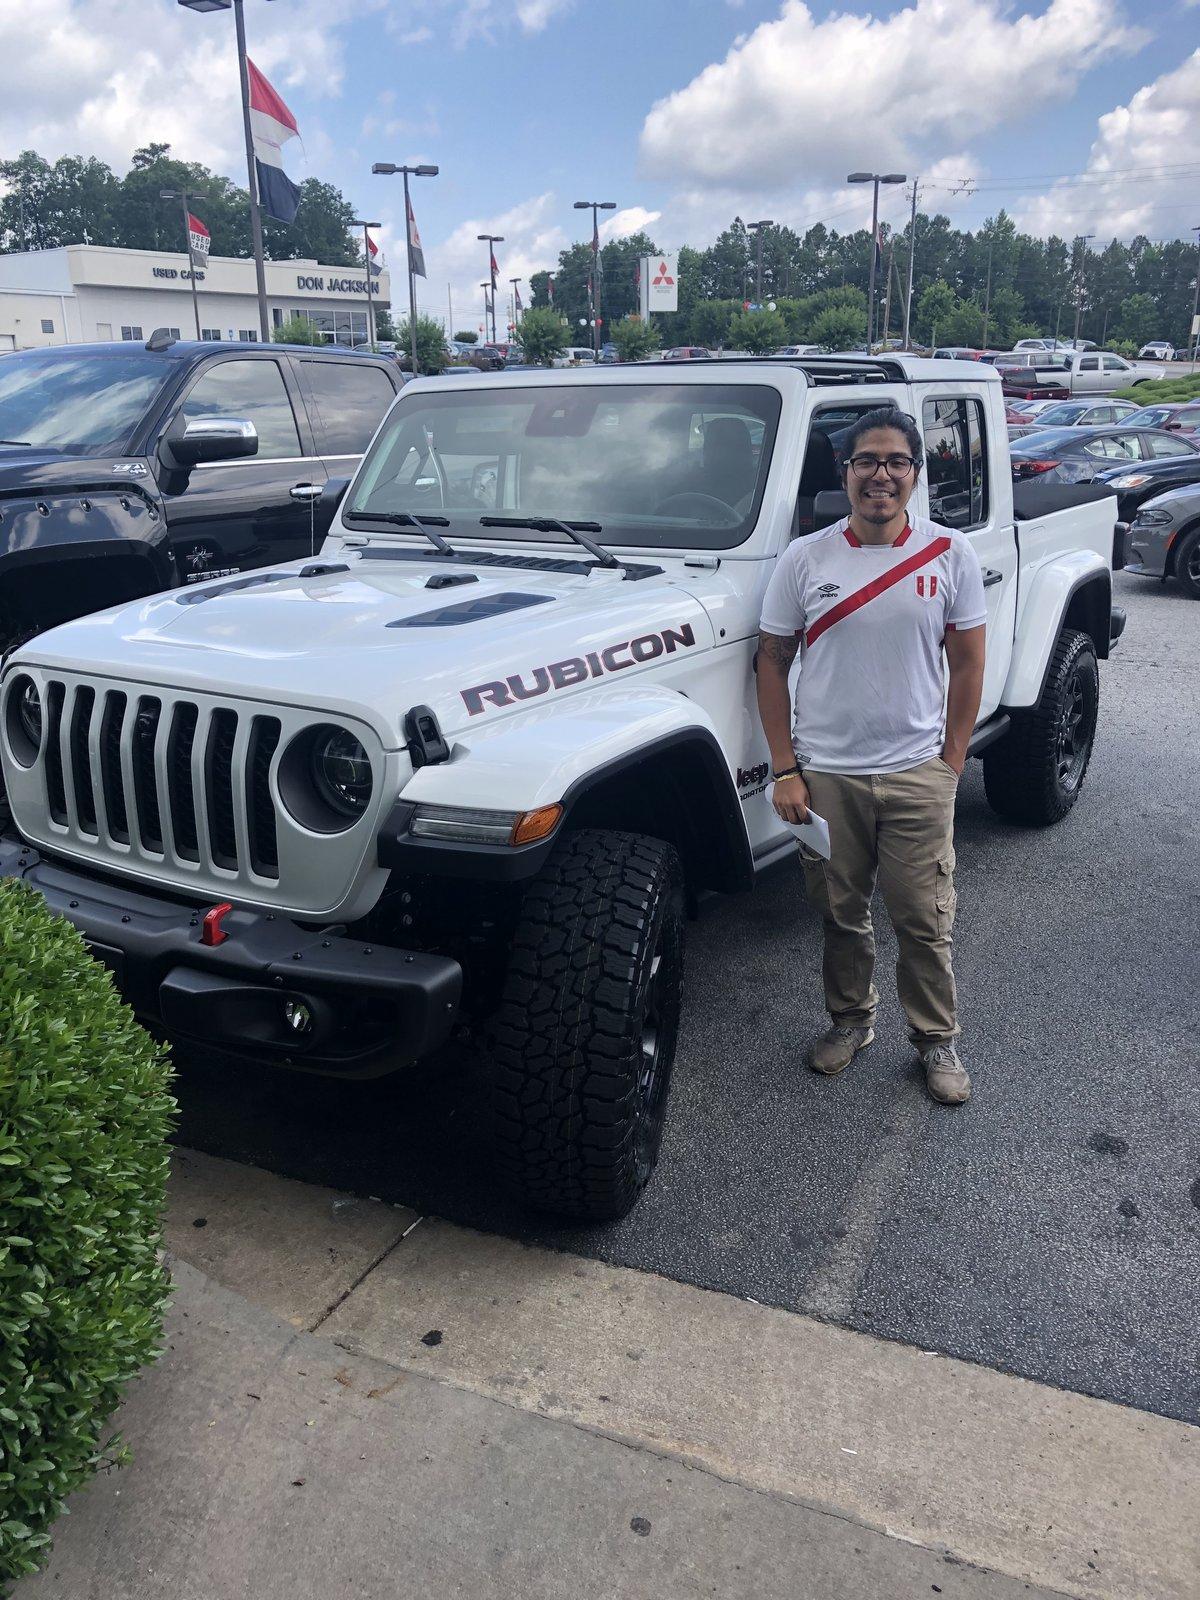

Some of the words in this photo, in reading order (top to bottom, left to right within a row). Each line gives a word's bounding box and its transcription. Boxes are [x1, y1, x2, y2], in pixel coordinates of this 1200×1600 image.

[191, 232, 210, 245] USED
[152, 267, 178, 279] USED
[296, 275, 324, 291] DON
[327, 278, 380, 295] JACKSON
[459, 622, 696, 717] RUBICON
[736, 761, 769, 789] Jeep
